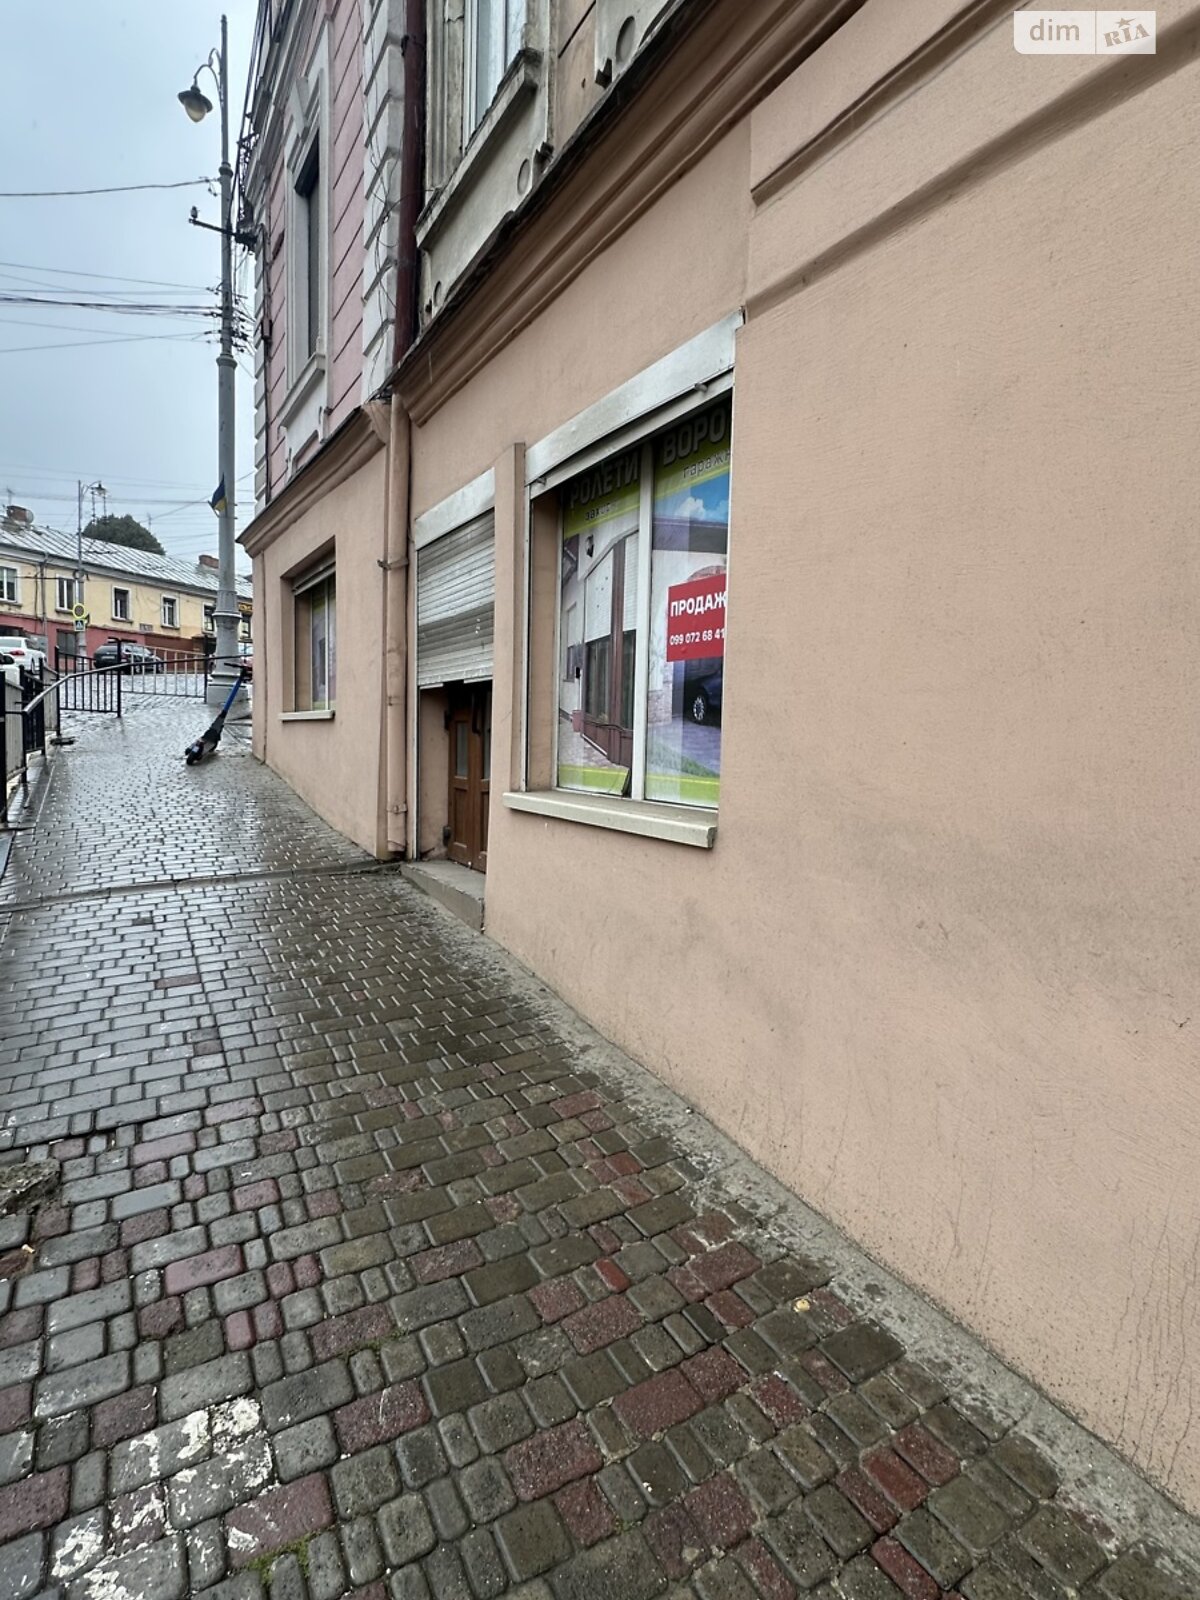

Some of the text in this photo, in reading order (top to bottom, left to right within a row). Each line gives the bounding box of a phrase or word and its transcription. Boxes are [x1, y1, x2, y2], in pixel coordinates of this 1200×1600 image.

[663, 406, 729, 467] ВОРО
[569, 449, 639, 509] РОЛЕТИ
[670, 590, 727, 617] ПРОДАЖ
[669, 633, 684, 646] 099
[685, 631, 701, 644] 072
[702, 629, 713, 642] 68
